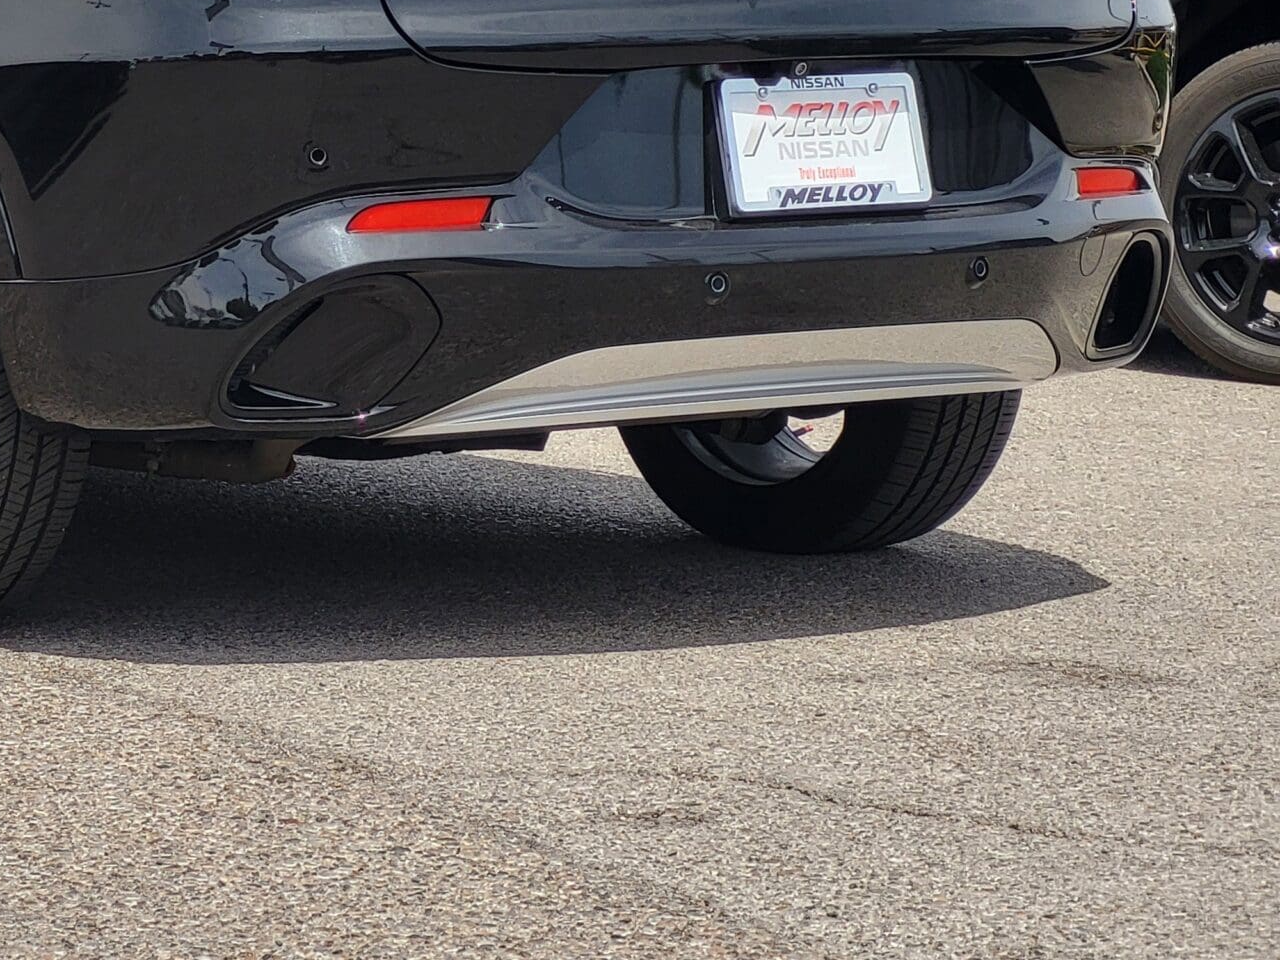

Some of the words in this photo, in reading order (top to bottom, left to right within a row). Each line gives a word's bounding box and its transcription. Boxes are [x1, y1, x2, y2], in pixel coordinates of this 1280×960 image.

[790, 77, 845, 89] NISSAN
[744, 99, 900, 157] MELLOY
[778, 140, 870, 160] NISSAN
[798, 167, 816, 182] Truly
[817, 166, 857, 180] Exceptional
[779, 183, 884, 208] MELLOY
